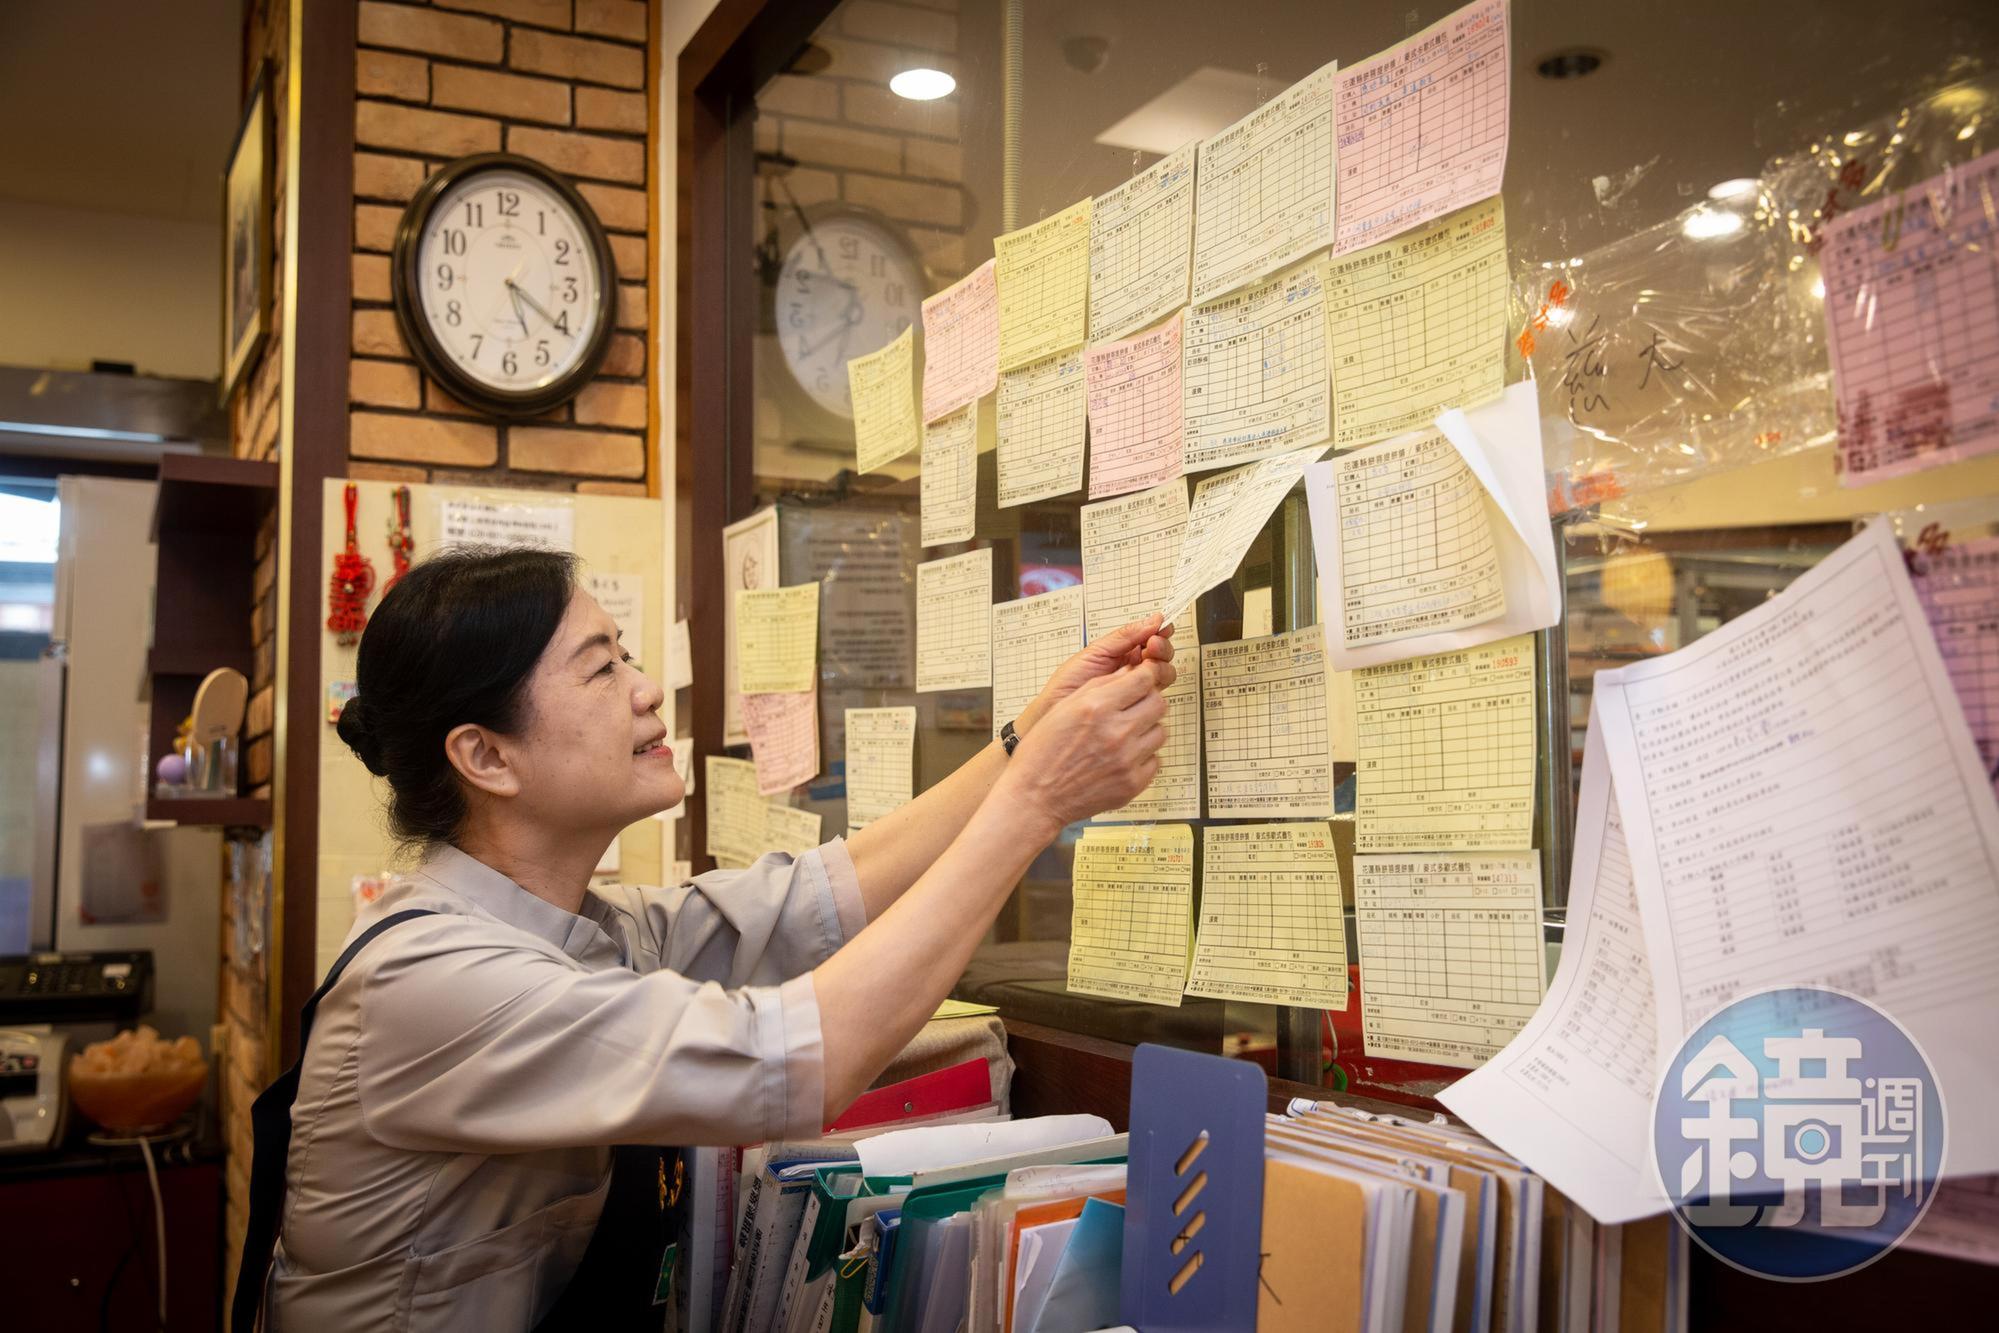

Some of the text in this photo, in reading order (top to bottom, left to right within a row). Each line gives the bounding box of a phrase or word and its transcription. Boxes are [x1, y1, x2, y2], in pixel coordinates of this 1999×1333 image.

[466, 203, 484, 227] 11
[497, 192, 520, 216] 12
[538, 211, 544, 235] 1
[444, 230, 466, 256] 10
[555, 240, 570, 265] 2
[438, 264, 454, 290] 9
[564, 278, 578, 304] 3
[446, 301, 462, 326] 8
[554, 310, 569, 336] 4
[470, 334, 484, 360] 7
[536, 340, 550, 366] 5
[502, 350, 518, 376] 6
